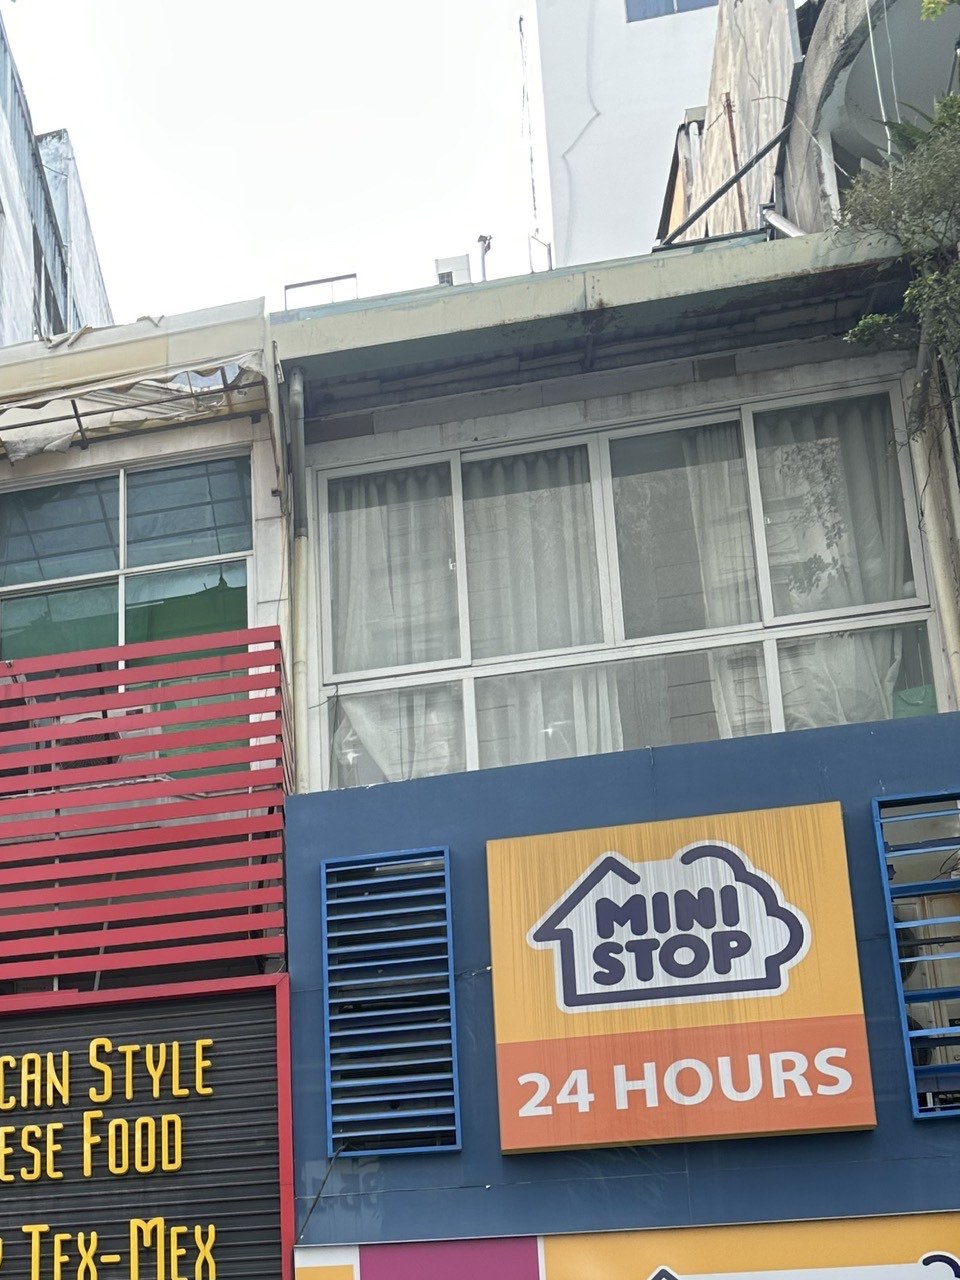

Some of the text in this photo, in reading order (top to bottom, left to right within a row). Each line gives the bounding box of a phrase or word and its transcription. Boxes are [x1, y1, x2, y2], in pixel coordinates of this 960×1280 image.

[594, 883, 738, 941] MINI
[592, 930, 752, 986] STOP
[88, 1037, 214, 1103] STYLE
[517, 1046, 854, 1118] 24 HOURS
[82, 1109, 183, 1177] FOOD
